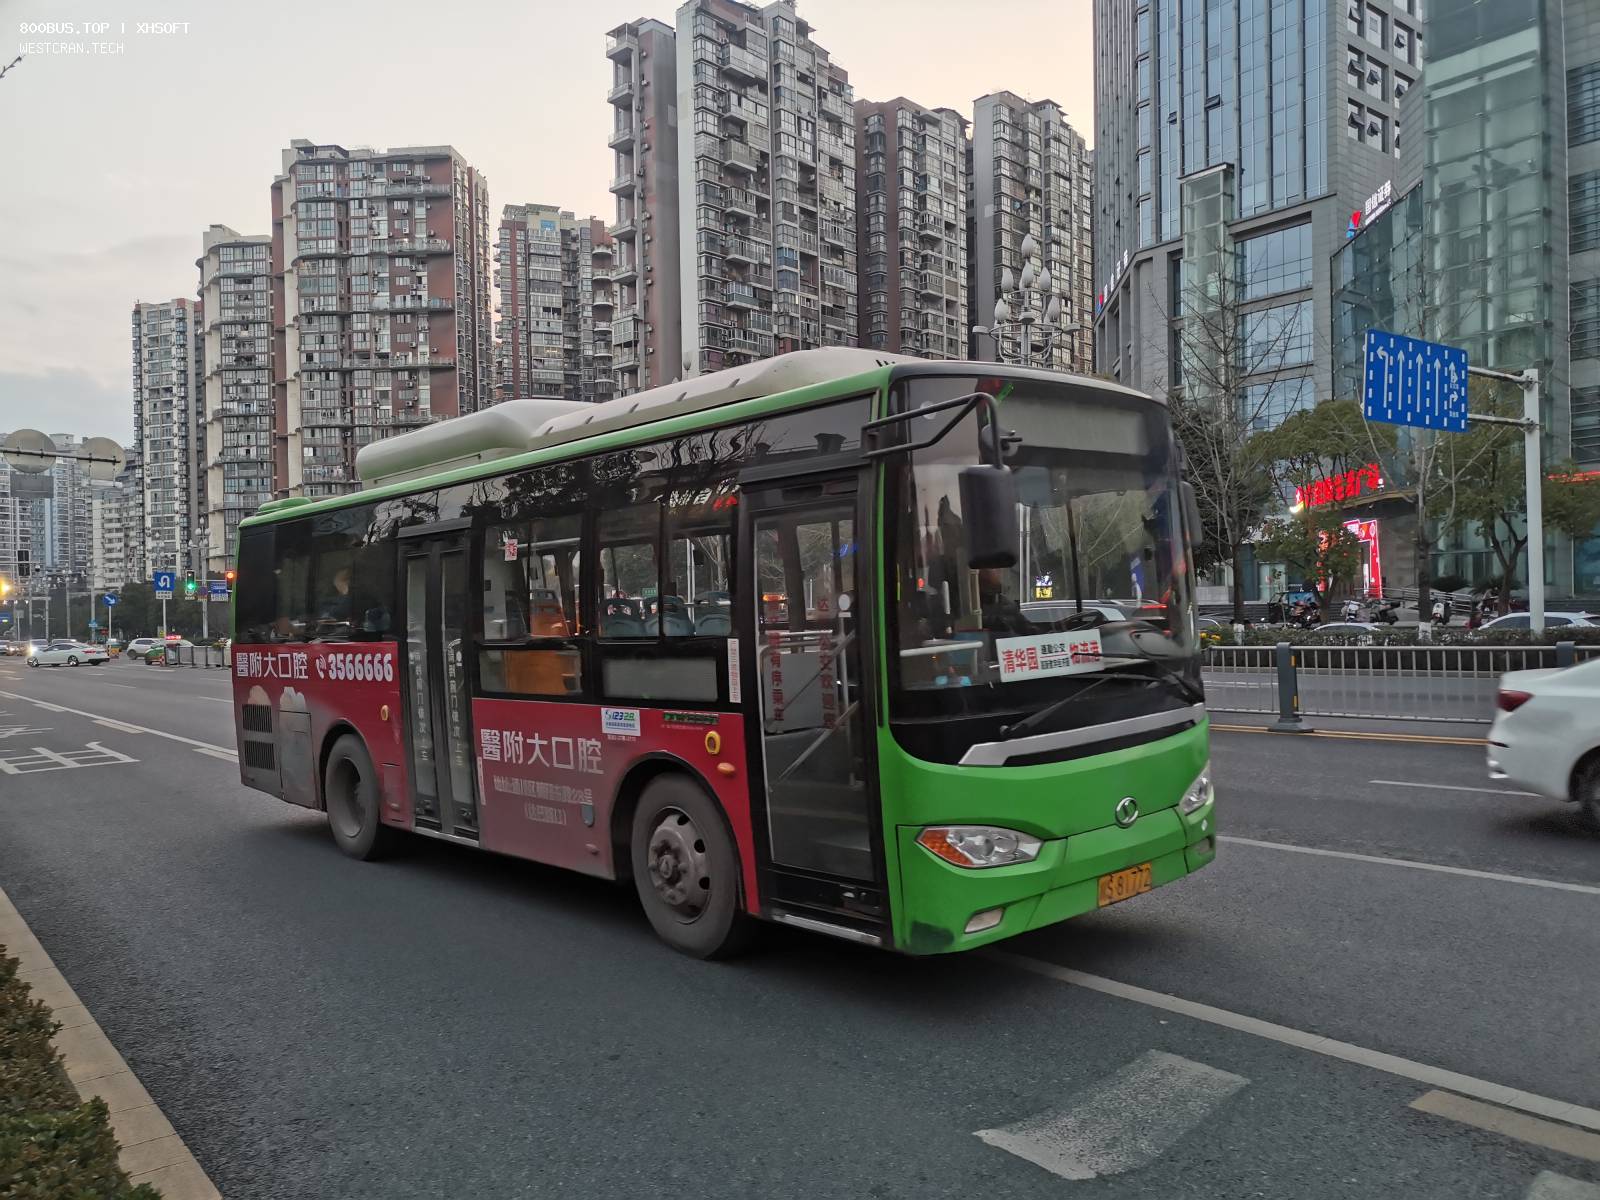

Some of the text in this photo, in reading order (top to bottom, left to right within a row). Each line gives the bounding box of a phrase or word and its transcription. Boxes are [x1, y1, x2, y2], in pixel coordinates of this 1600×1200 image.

[236, 652, 394, 682] 醫附大口腔 3566666
[1001, 646, 1039, 674] 清华园
[480, 728, 605, 775] 醫附大口腔
